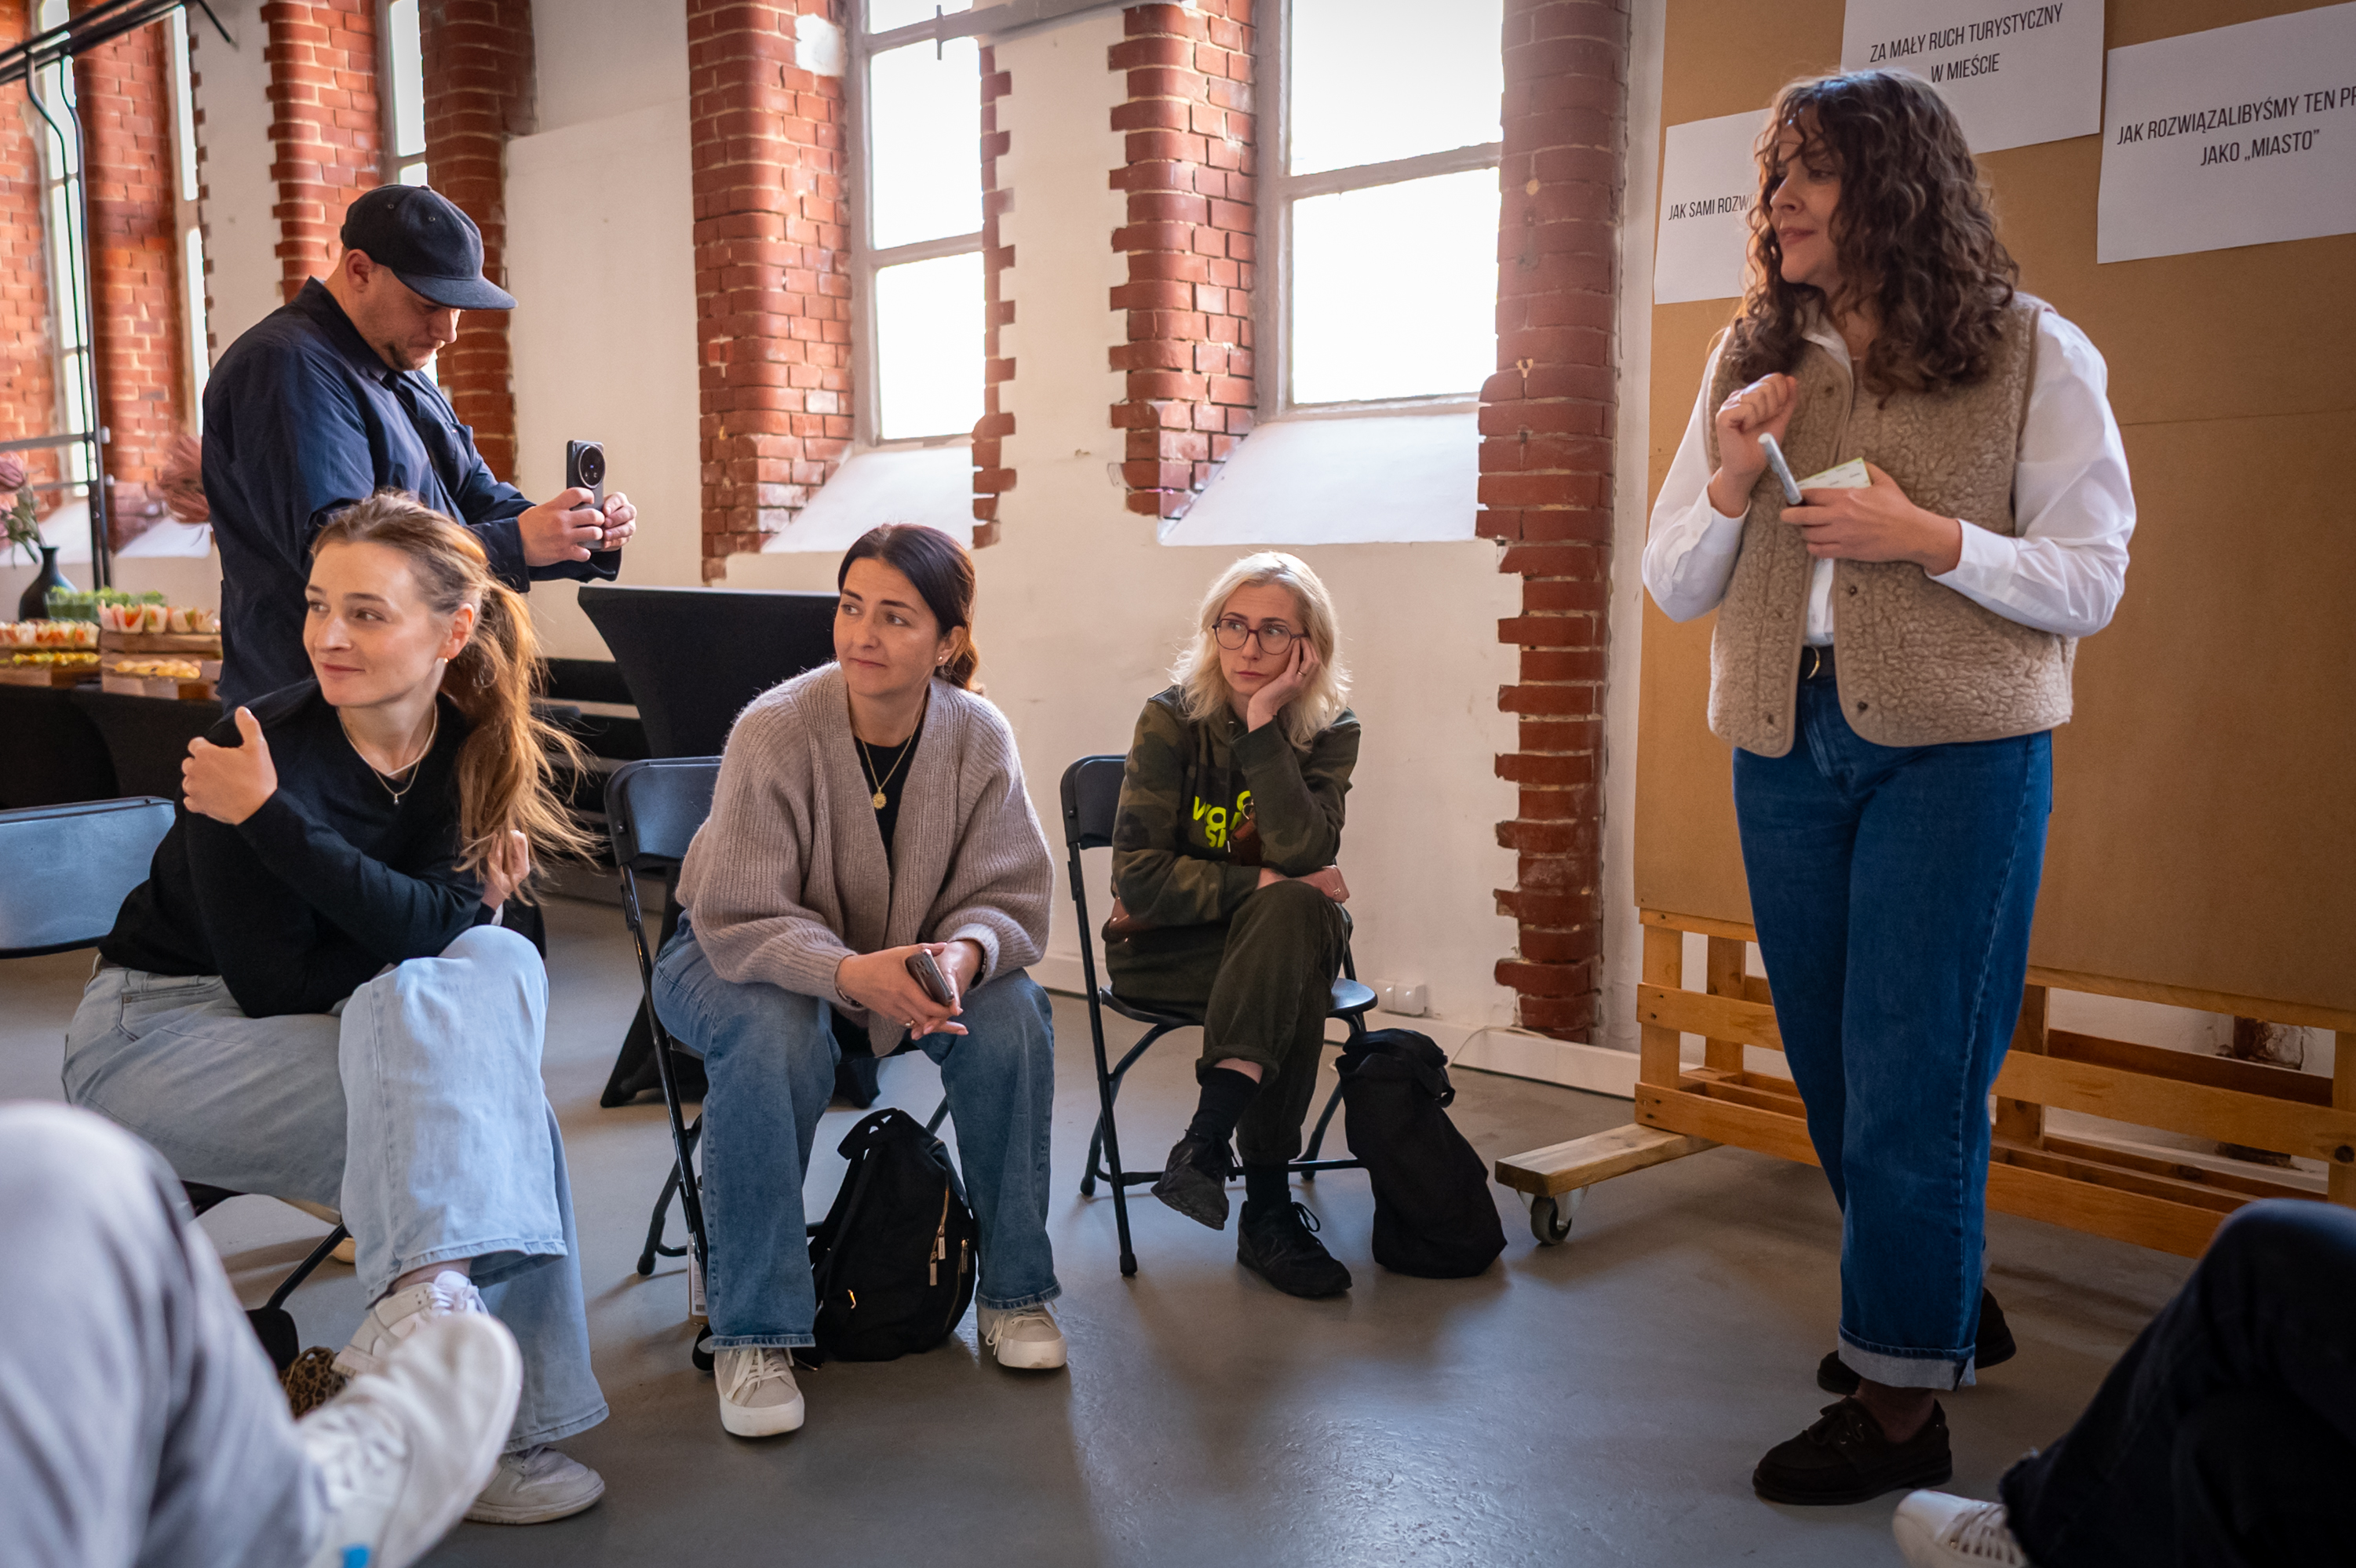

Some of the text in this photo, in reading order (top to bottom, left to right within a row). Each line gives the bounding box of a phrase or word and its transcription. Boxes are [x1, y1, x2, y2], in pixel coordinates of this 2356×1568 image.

[1869, 2, 2062, 63] ZA MAŁY RUCH TURYSTYCZNY
[1931, 53, 2000, 82] W MIEŚCIE
[2117, 122, 2143, 145] JAK
[2147, 96, 2299, 140] ROZWIĄZALIBYŚMY
[2303, 89, 2335, 113] TEN
[2200, 142, 2239, 166] JAKO
[1669, 203, 1687, 221] JAK
[1689, 199, 1715, 217] SAMI
